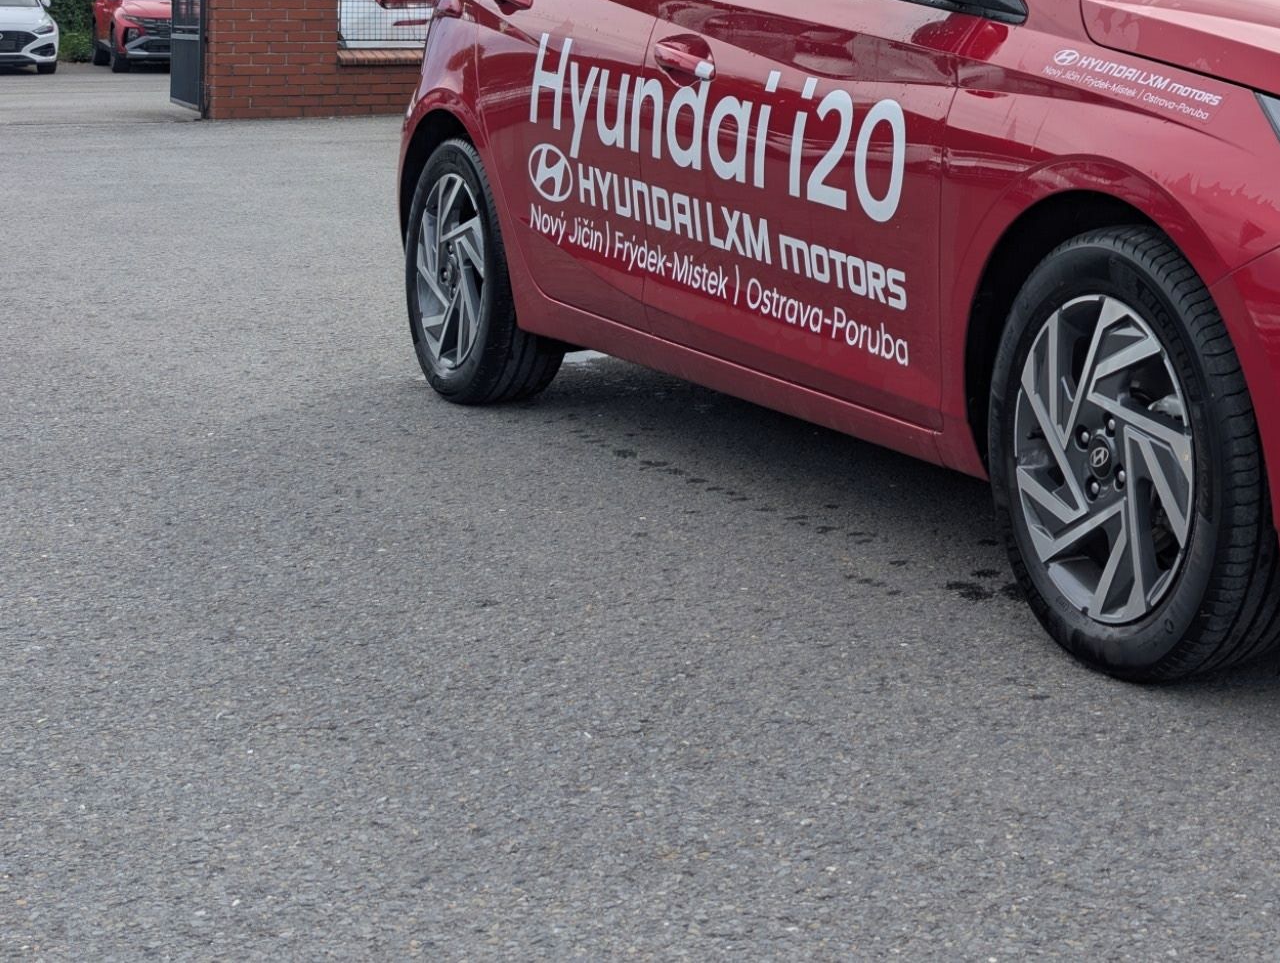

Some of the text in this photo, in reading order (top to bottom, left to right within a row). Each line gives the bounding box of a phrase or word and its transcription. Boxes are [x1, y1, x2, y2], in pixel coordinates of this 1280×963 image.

[530, 33, 907, 223] Hyundai i20
[1078, 56, 1223, 106] HYUNDAI LXM MOTORS
[1143, 92, 1209, 119] Ostrava-Poruba
[529, 203, 910, 367] Nový Jičín Frýdek-Místek Ostrava-Poruba
[577, 162, 907, 311] HYUNDAI LXM MOTORS
